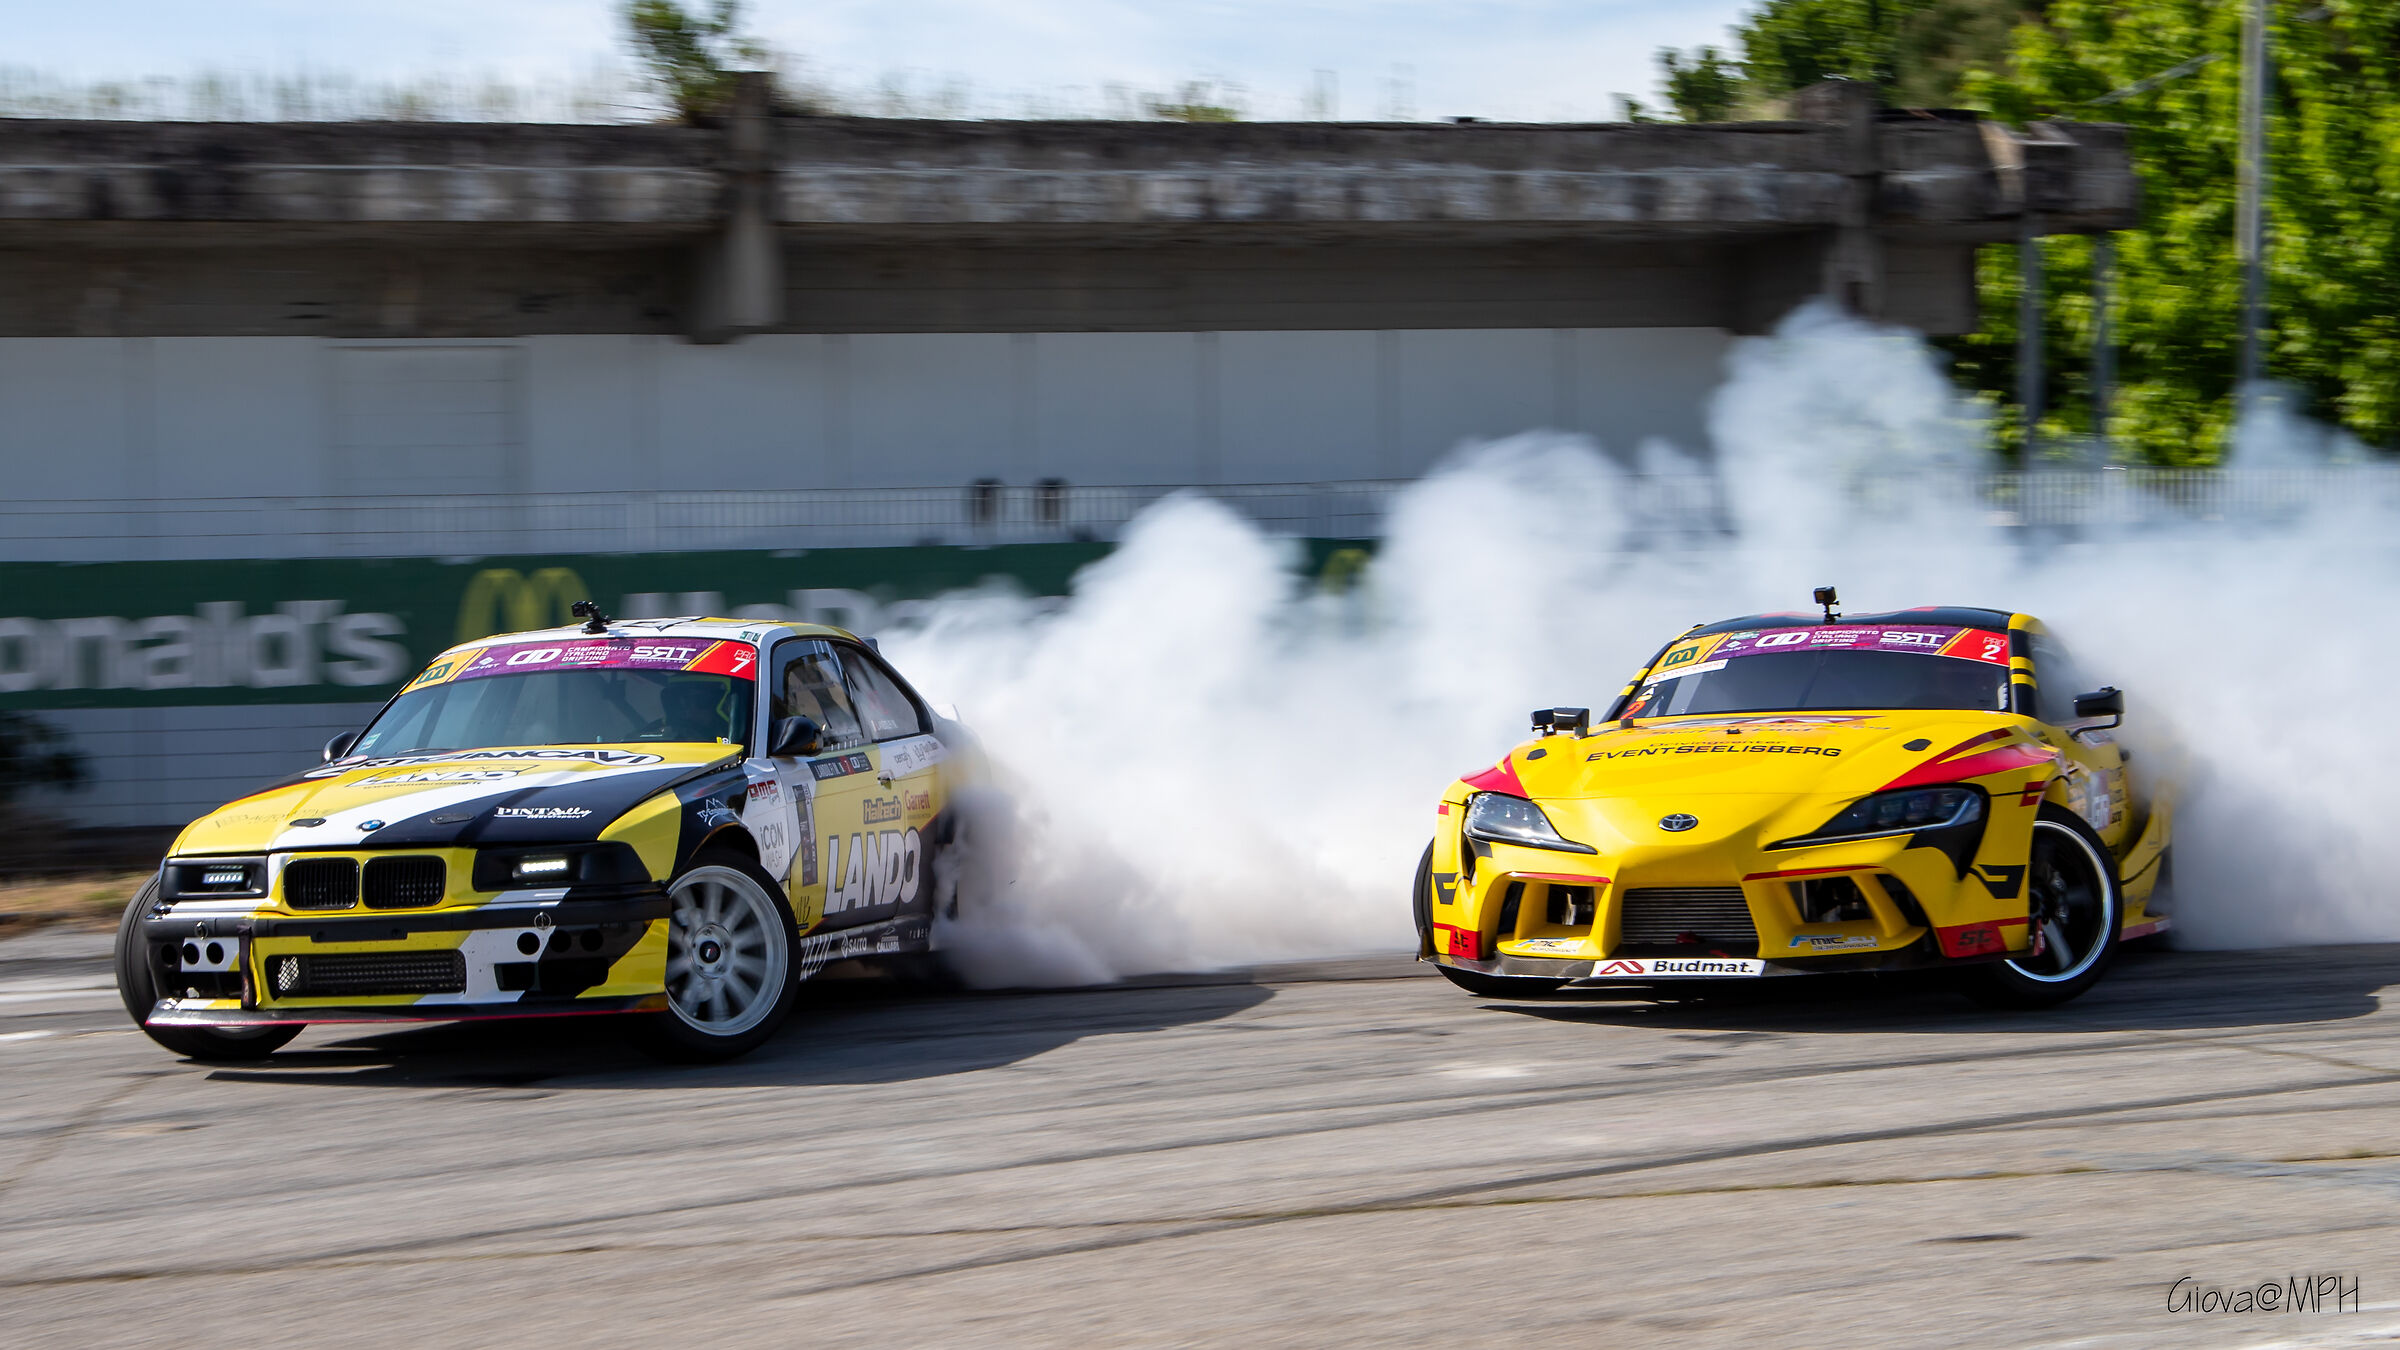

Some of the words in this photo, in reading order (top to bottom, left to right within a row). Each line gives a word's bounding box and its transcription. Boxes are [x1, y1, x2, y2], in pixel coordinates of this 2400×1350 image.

[1982, 637, 2007, 647] PRO
[733, 649, 756, 661] PRO
[1981, 645, 2001, 660] 2
[730, 658, 751, 673] 7
[904, 789, 931, 811] Garrett
[863, 796, 901, 824] Haltech
[823, 827, 921, 915] LANDO
[848, 937, 867, 953] SAITO
[1653, 960, 1754, 973] Budmat.
